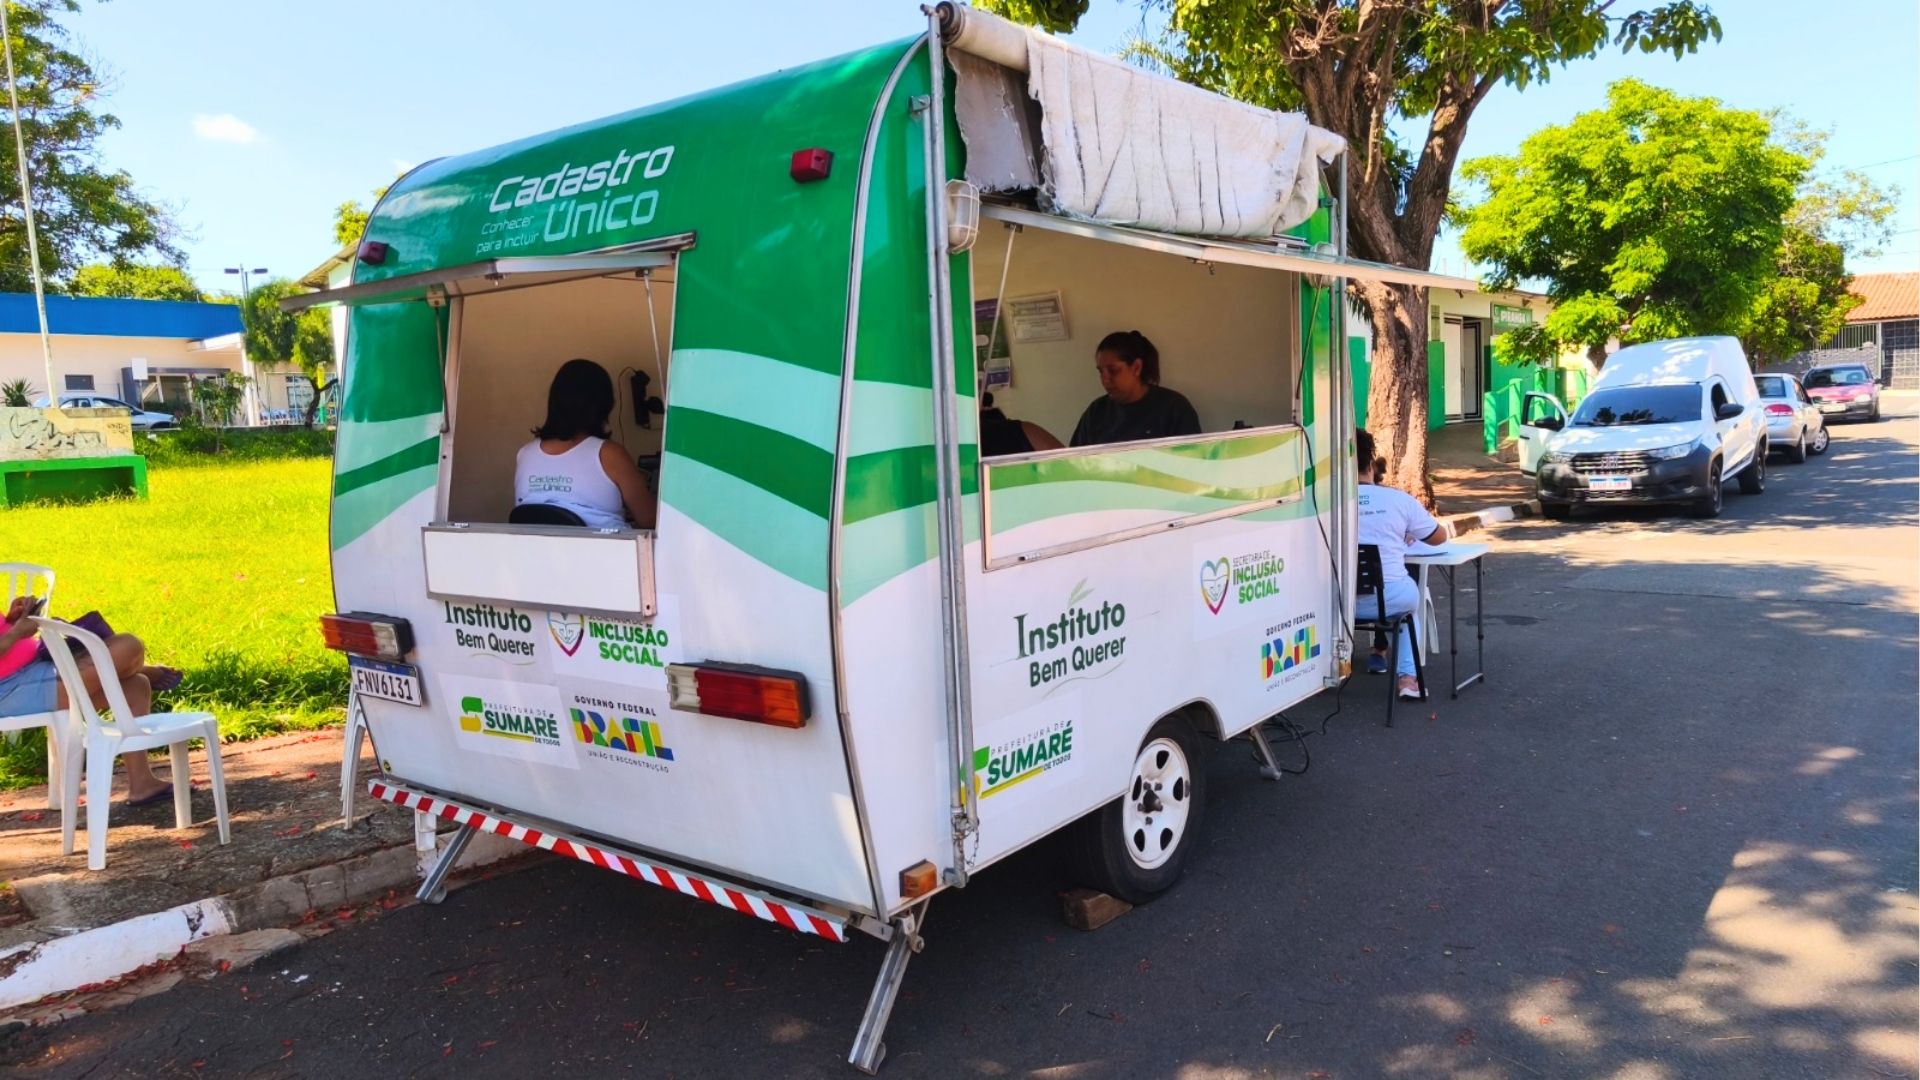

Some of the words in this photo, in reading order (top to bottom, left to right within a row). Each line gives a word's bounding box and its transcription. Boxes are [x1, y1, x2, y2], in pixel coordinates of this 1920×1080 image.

[489, 145, 674, 213] Cadastro
[481, 215, 535, 235] Conhecer
[543, 189, 660, 242] Único
[475, 240, 502, 256] para
[503, 232, 539, 249] incluir
[528, 474, 573, 484] Cadastro
[1233, 556, 1285, 585] INCLUSÃO
[1238, 577, 1280, 604] SOCIAL
[444, 601, 532, 633] Instituto
[1013, 601, 1126, 660] Instituto
[1266, 619, 1292, 637] GOVERNO
[1292, 611, 1316, 627] FEDERAL
[456, 628, 485, 650] Bem
[488, 632, 535, 657] Querer
[589, 622, 669, 648] INCLUSÃO
[599, 641, 664, 668] SOCIAL
[1029, 658, 1067, 687] Bem
[1071, 637, 1126, 671] Querer
[1260, 624, 1321, 681] BRASIL
[357, 669, 413, 701] FNV6131
[483, 702, 536, 716] PREFEITURA
[574, 695, 614, 710] GOVERNO
[617, 702, 657, 717] FEDERAL
[484, 711, 560, 739] SUMARÉ
[569, 707, 675, 762] BRASIL
[990, 726, 1051, 756] PREFEITURA
[1053, 721, 1064, 732] DE
[542, 738, 561, 747] TODOS
[987, 719, 1073, 786] SUMARÉ
[588, 750, 608, 761] UNIÃO
[616, 756, 670, 774] RECONSTRUÇÃO
[1043, 762, 1052, 771] DE
[1052, 753, 1072, 768] TODOS
